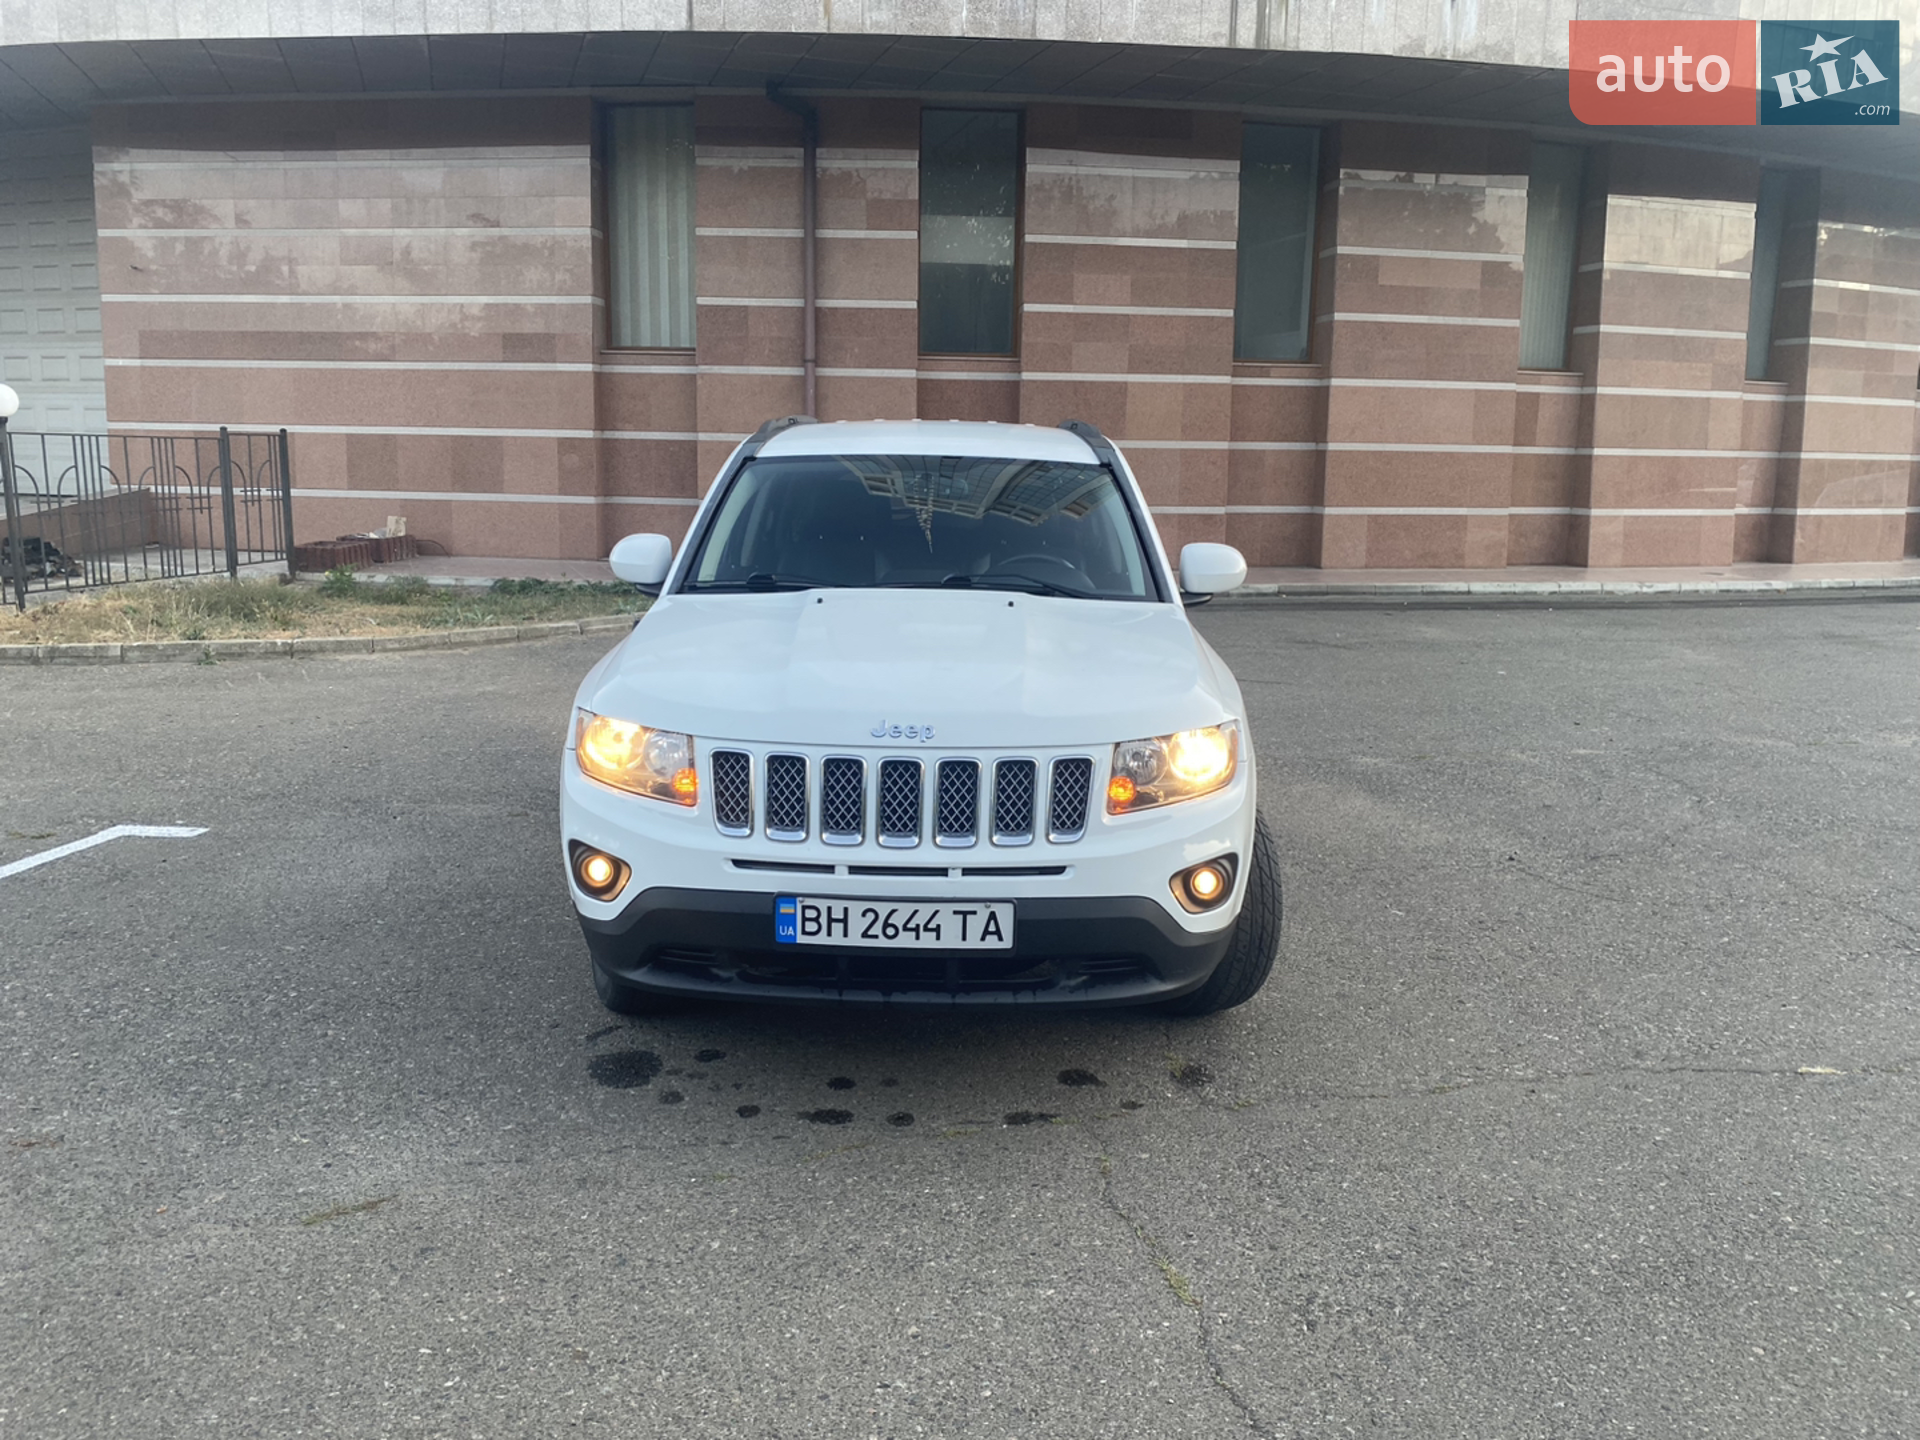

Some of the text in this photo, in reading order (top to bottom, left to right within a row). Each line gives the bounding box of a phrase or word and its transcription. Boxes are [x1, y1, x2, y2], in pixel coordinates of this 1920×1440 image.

[871, 719, 935, 743] Jeep
[779, 925, 795, 936] UA
[800, 904, 1005, 942] BH 2644 TA
